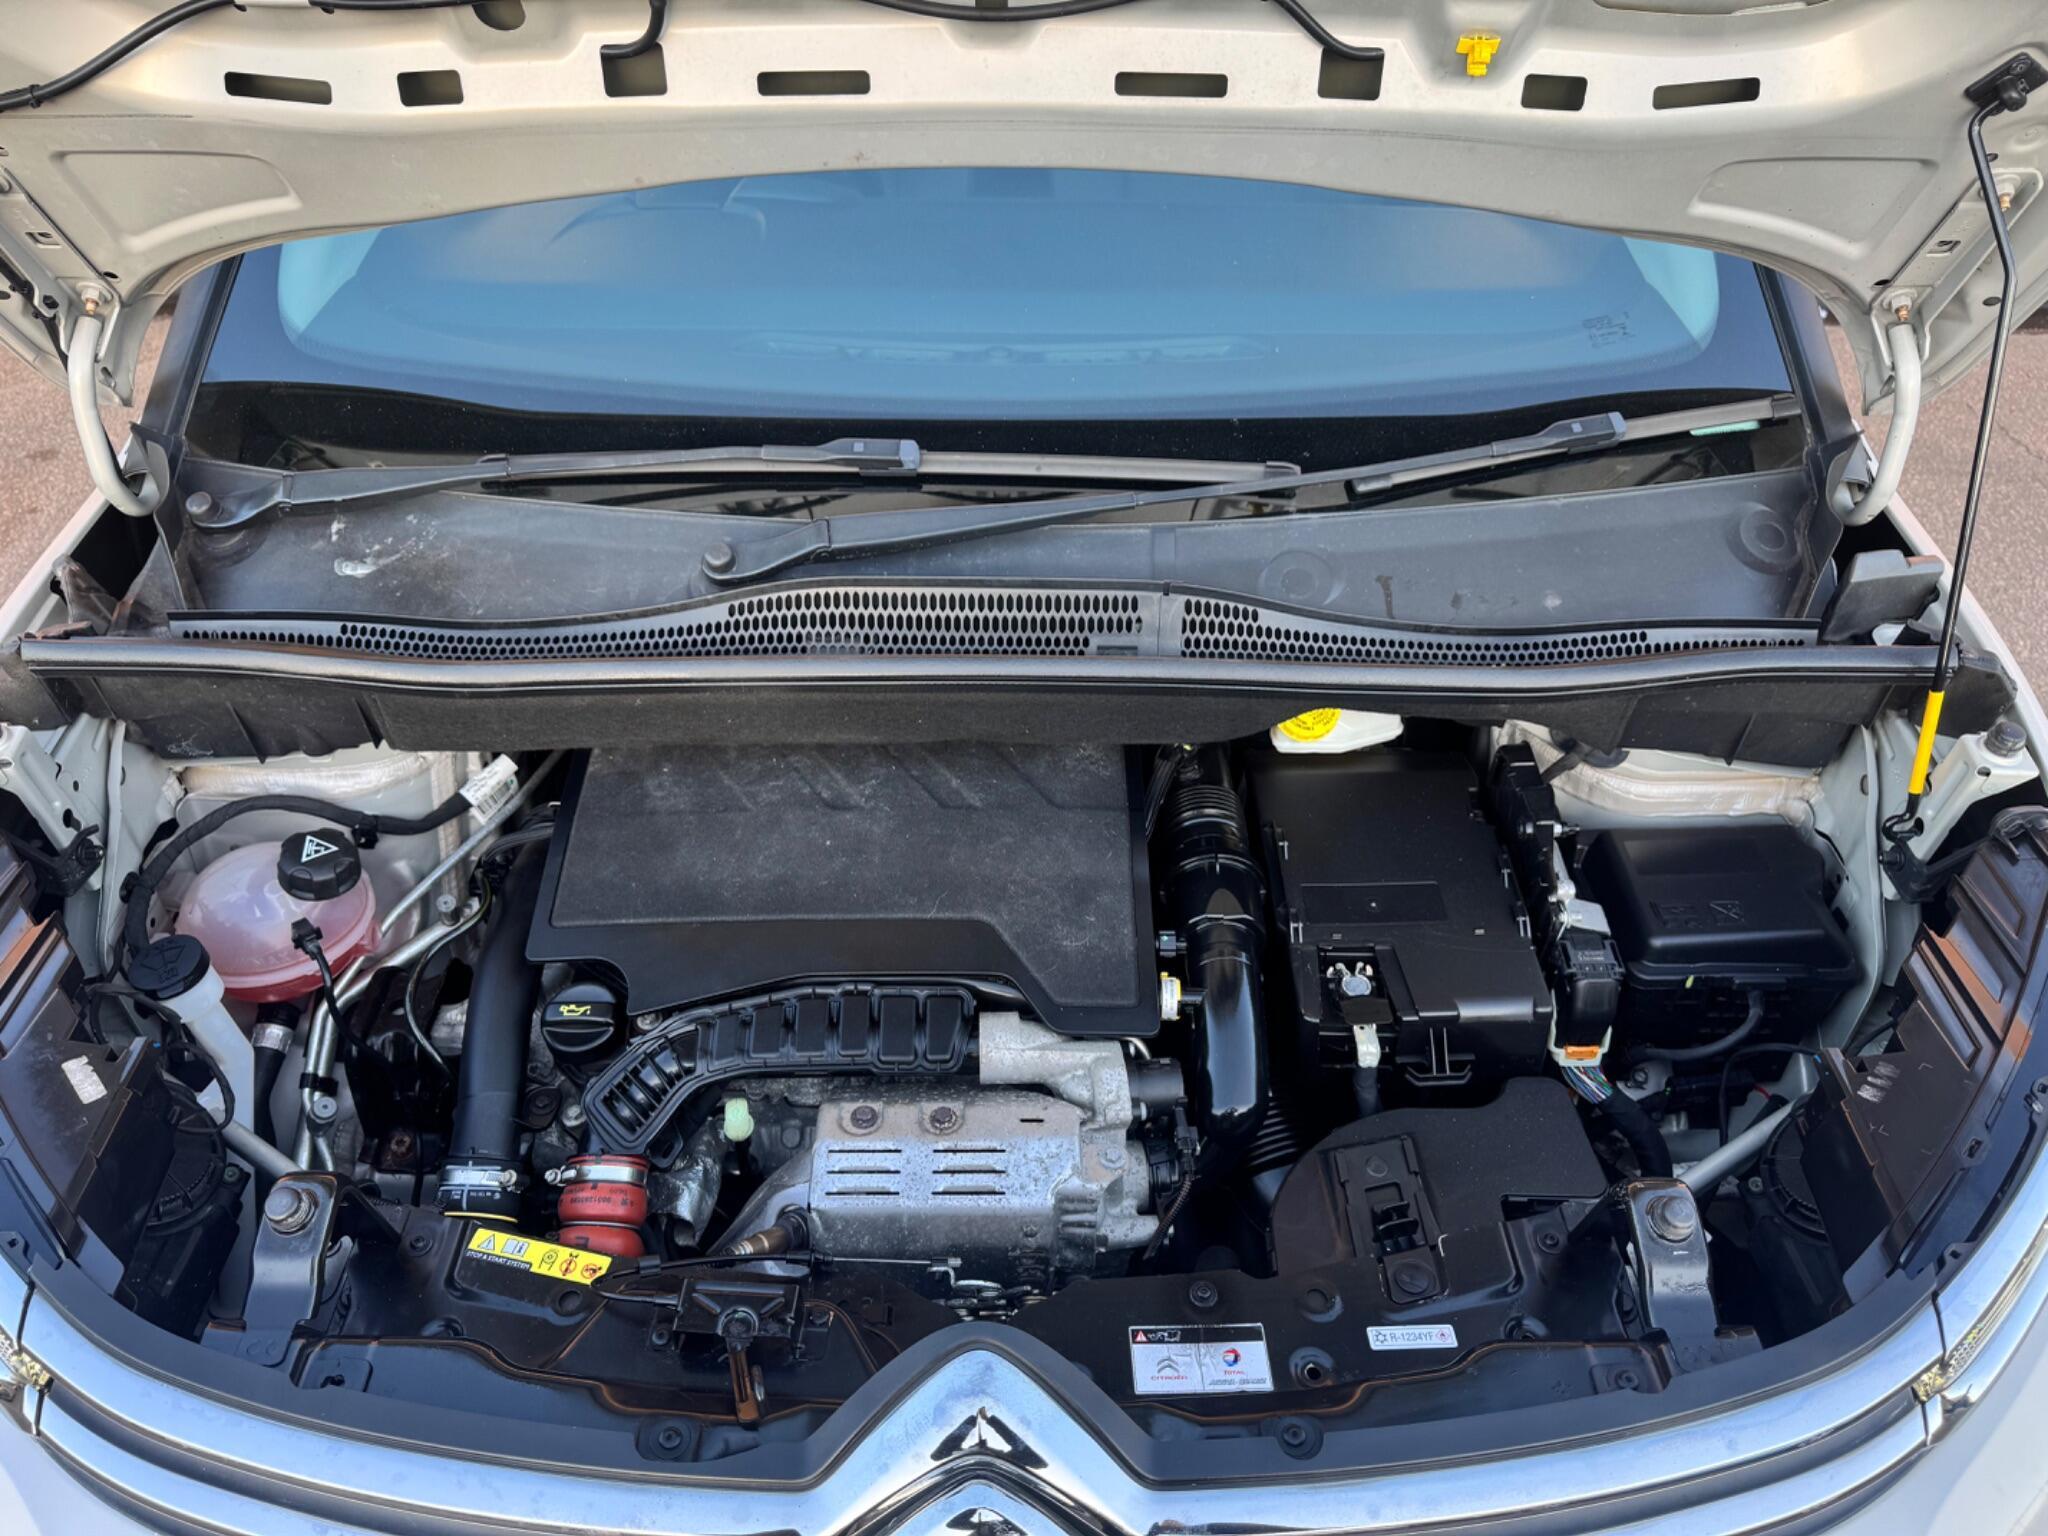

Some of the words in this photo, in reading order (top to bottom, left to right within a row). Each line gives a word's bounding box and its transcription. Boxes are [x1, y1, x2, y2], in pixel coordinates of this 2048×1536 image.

[465, 1250, 482, 1259] STOP
[487, 1255, 507, 1265] START
[506, 1260, 530, 1269] SYSTEM
